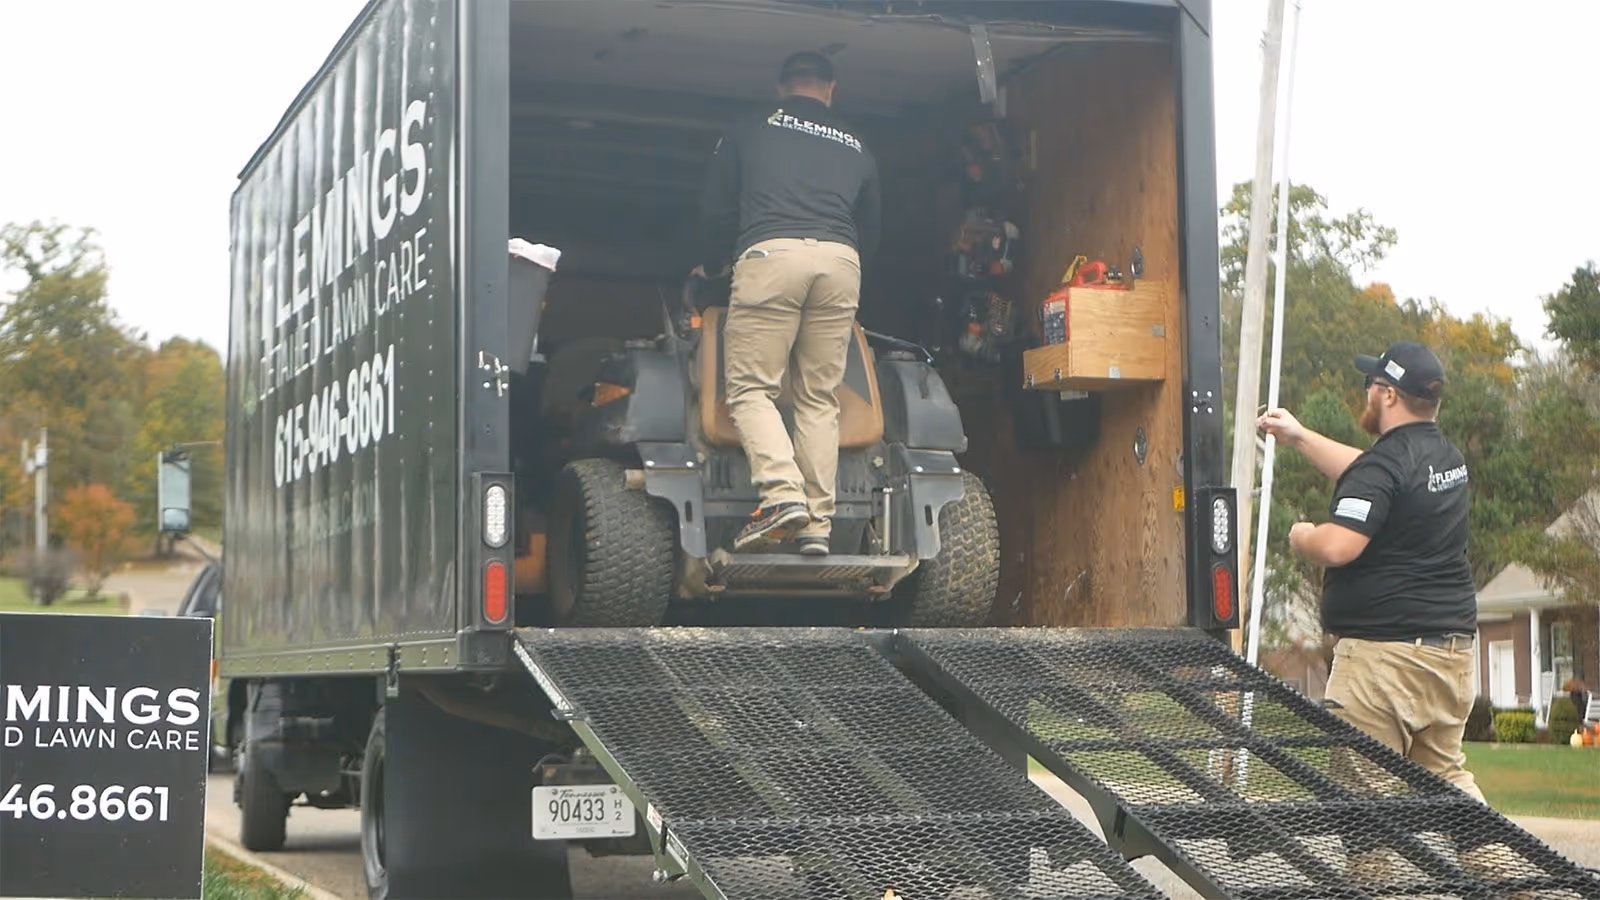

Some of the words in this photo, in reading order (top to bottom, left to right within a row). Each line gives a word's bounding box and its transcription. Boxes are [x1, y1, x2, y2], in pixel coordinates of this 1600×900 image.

[783, 114, 862, 149] FLEMINGS
[262, 99, 426, 342] FLEMINGS
[323, 272, 370, 356] LAWN
[374, 226, 428, 317] CARE
[273, 343, 395, 489] 615-946-8661
[5, 684, 200, 726] MINGS
[35, 727, 116, 749] LAWN
[127, 729, 200, 751] CARE
[0, 783, 170, 822] 46.8661
[549, 799, 605, 822] 90433
[614, 812, 622, 821] 2
